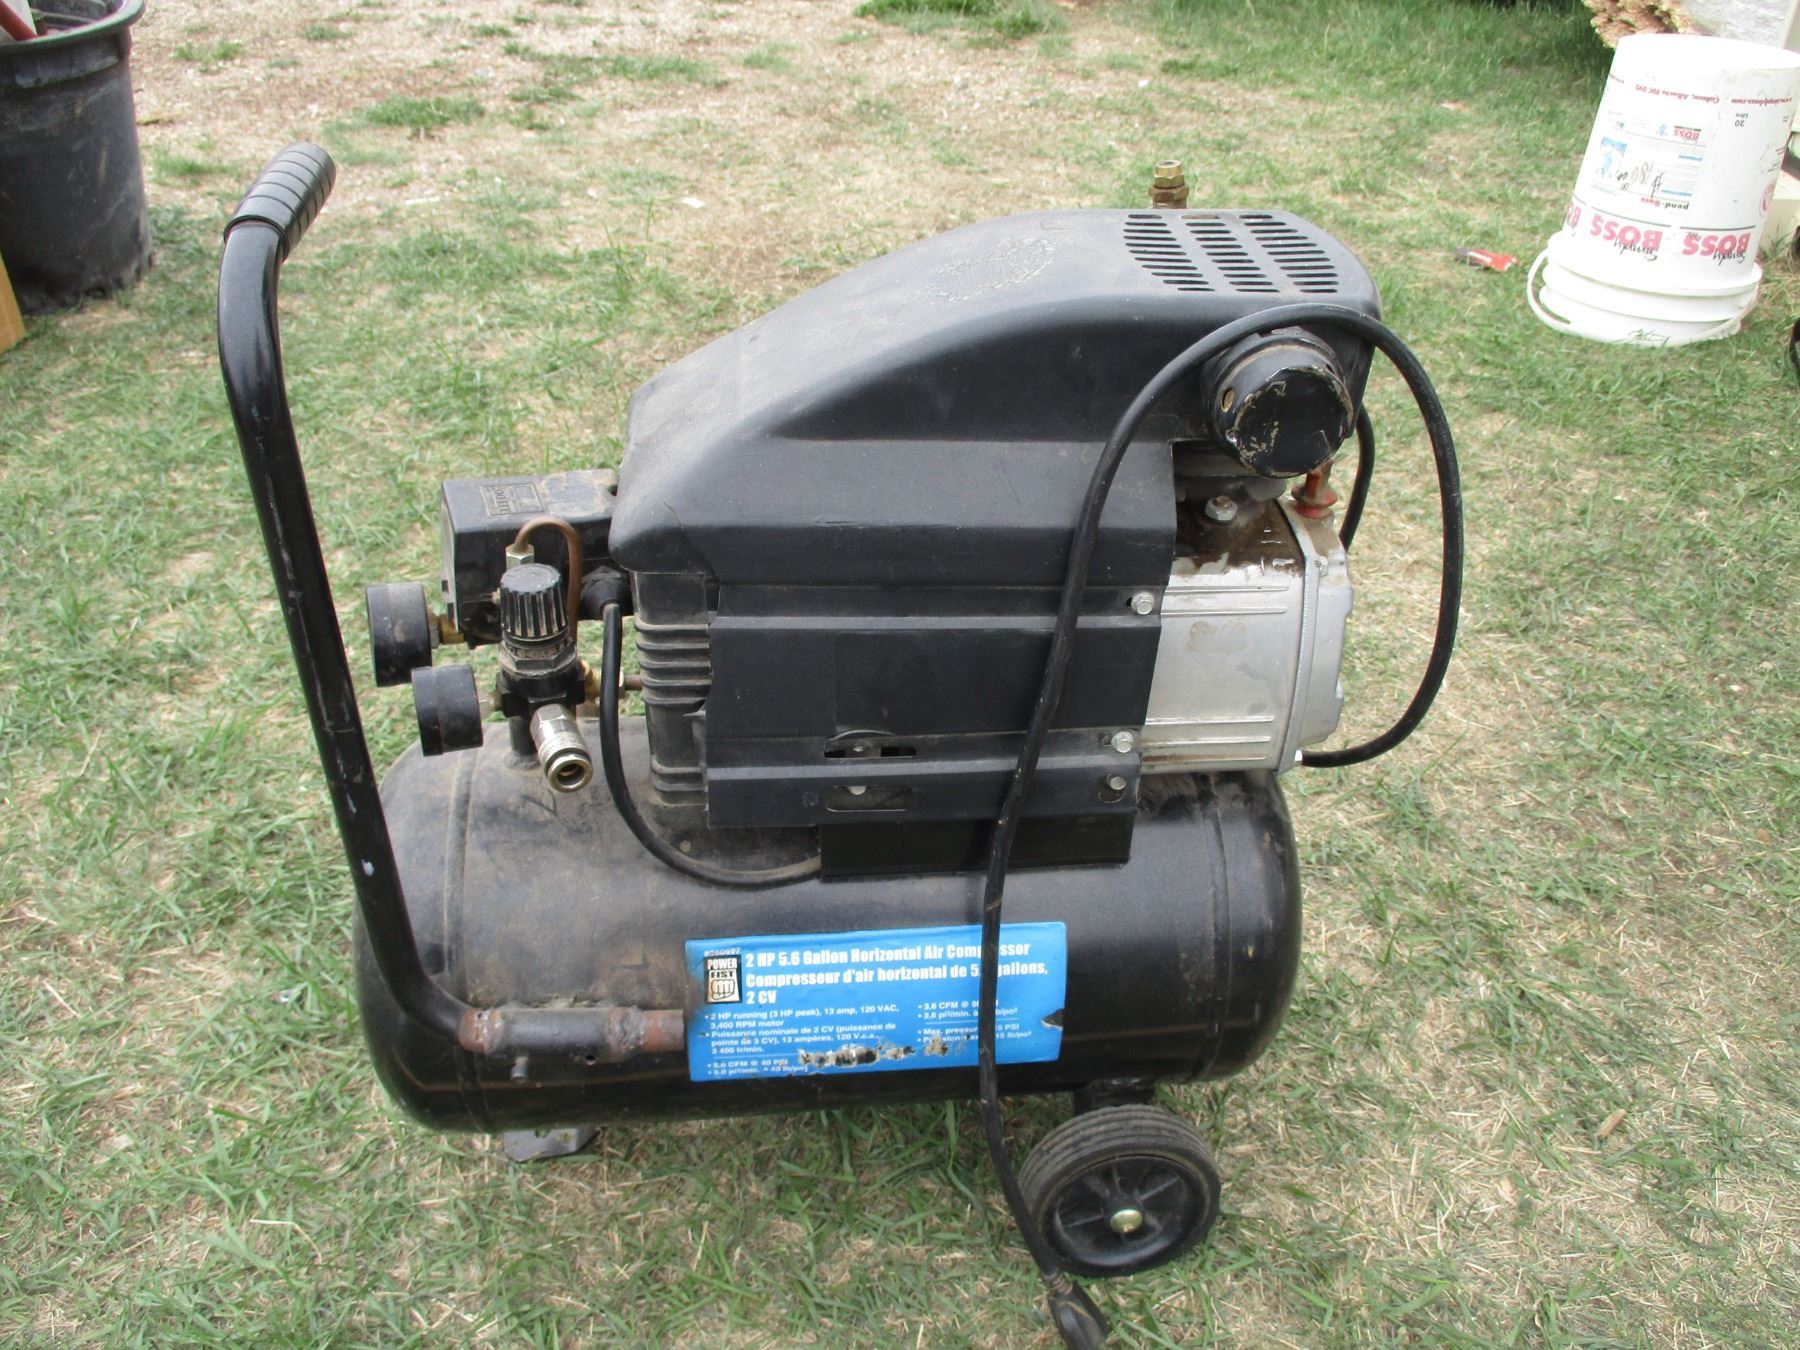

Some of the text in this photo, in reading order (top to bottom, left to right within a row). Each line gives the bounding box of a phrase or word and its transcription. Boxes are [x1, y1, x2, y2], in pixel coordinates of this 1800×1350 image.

[1734, 119, 1745, 128] 20
[1590, 213, 1663, 251] BOSS
[1681, 233, 1751, 256] BOSS
[746, 943, 1030, 968] 2 HP 5.6 Gallon Horizontal Air Compssor
[707, 958, 738, 970] POWER
[711, 970, 734, 979] FIST
[746, 970, 840, 988] Compresseur
[843, 968, 874, 984] d'air
[877, 965, 947, 982] horizontal
[951, 964, 968, 979] de
[746, 990, 777, 1005] 2 CV
[938, 1001, 959, 1010] CFM
[718, 1011, 732, 1020] HP
[733, 1010, 768, 1020] running
[780, 1009, 794, 1017] HP
[836, 1006, 858, 1015] amp,
[860, 1005, 876, 1013] 120
[877, 1004, 900, 1013] VAC,
[995, 1007, 1018, 1017] b/po²
[736, 1020, 757, 1028] RPM
[758, 1019, 784, 1027] motor
[945, 1025, 979, 1035] pressur
[1005, 1023, 1020, 1031] PSI
[711, 1029, 757, 1038] Puissance
[759, 1026, 799, 1036] nominale
[801, 1026, 812, 1034] de
[821, 1025, 834, 1033] CV
[836, 1022, 883, 1033] (puissance
[885, 1022, 897, 1030] de
[711, 1038, 739, 1048] pointe
[741, 1037, 752, 1046] de
[728, 1060, 748, 1068] CFM
